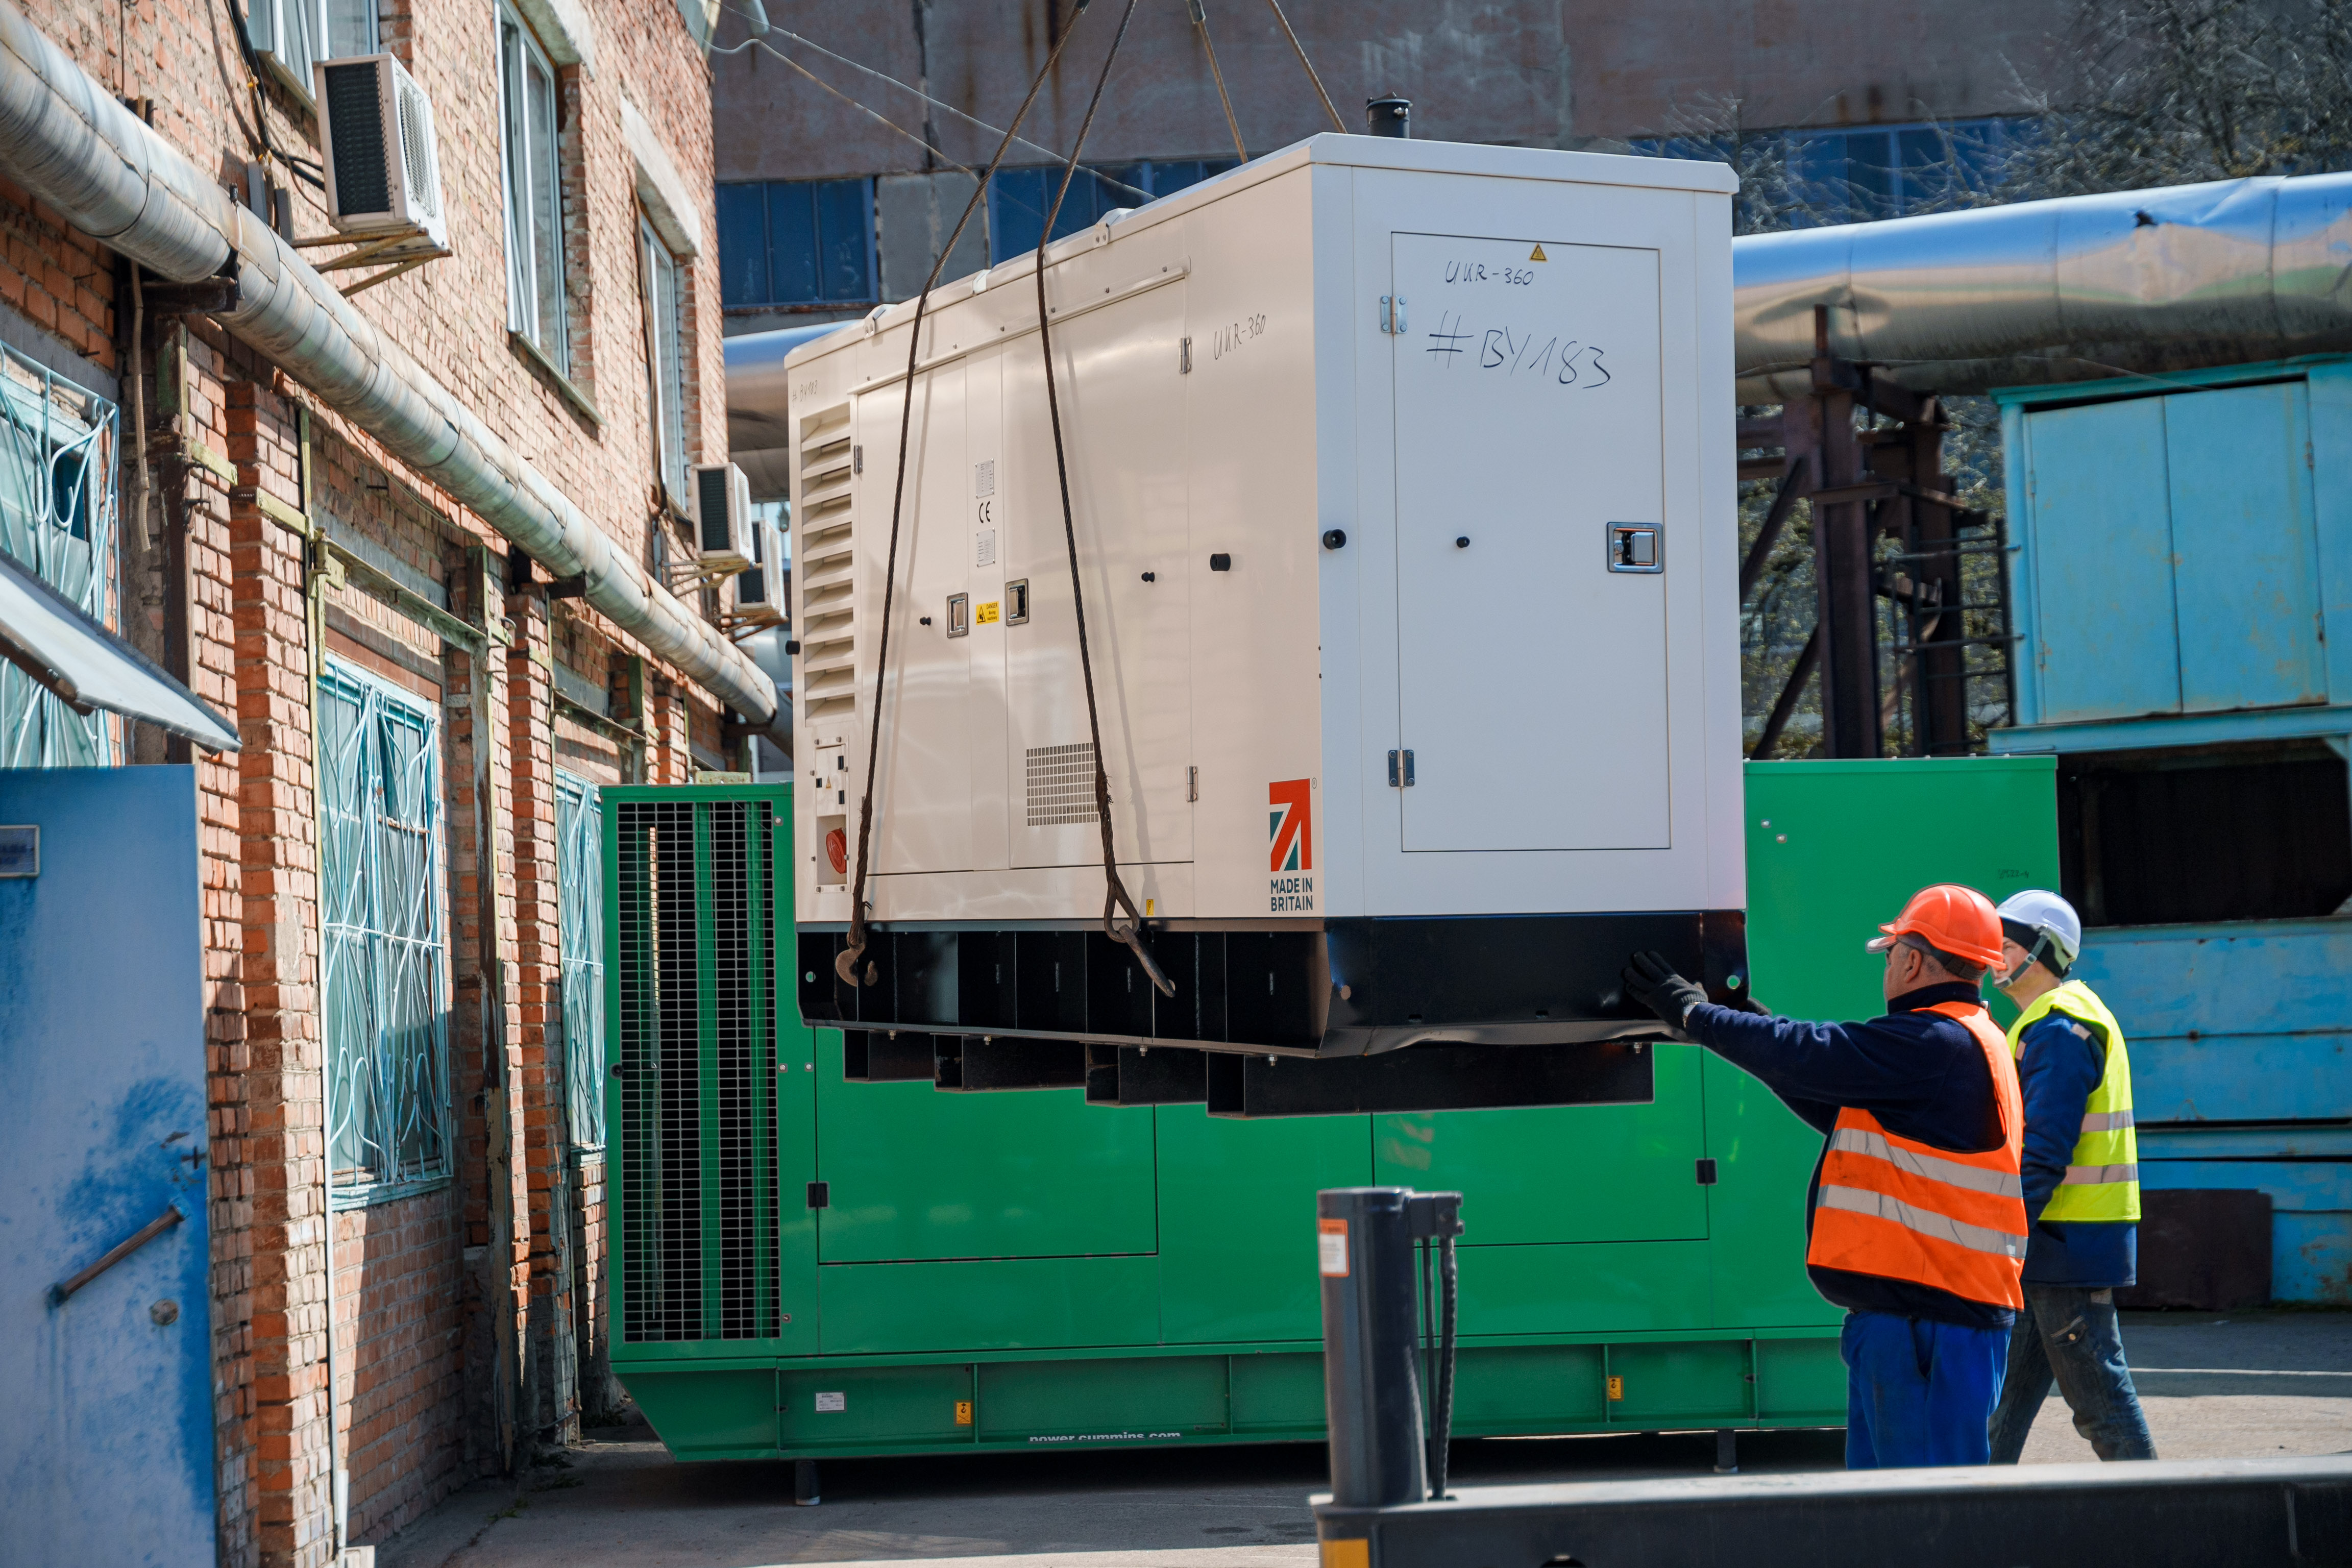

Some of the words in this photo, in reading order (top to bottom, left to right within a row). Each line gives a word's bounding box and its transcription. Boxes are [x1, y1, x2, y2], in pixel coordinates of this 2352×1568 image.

[978, 500, 991, 524] CE
[1270, 877, 1300, 894] MADE
[1302, 877, 1313, 893] IN
[1270, 895, 1313, 912] BRITAIN
[1030, 1431, 1181, 1442] powercumminscom
